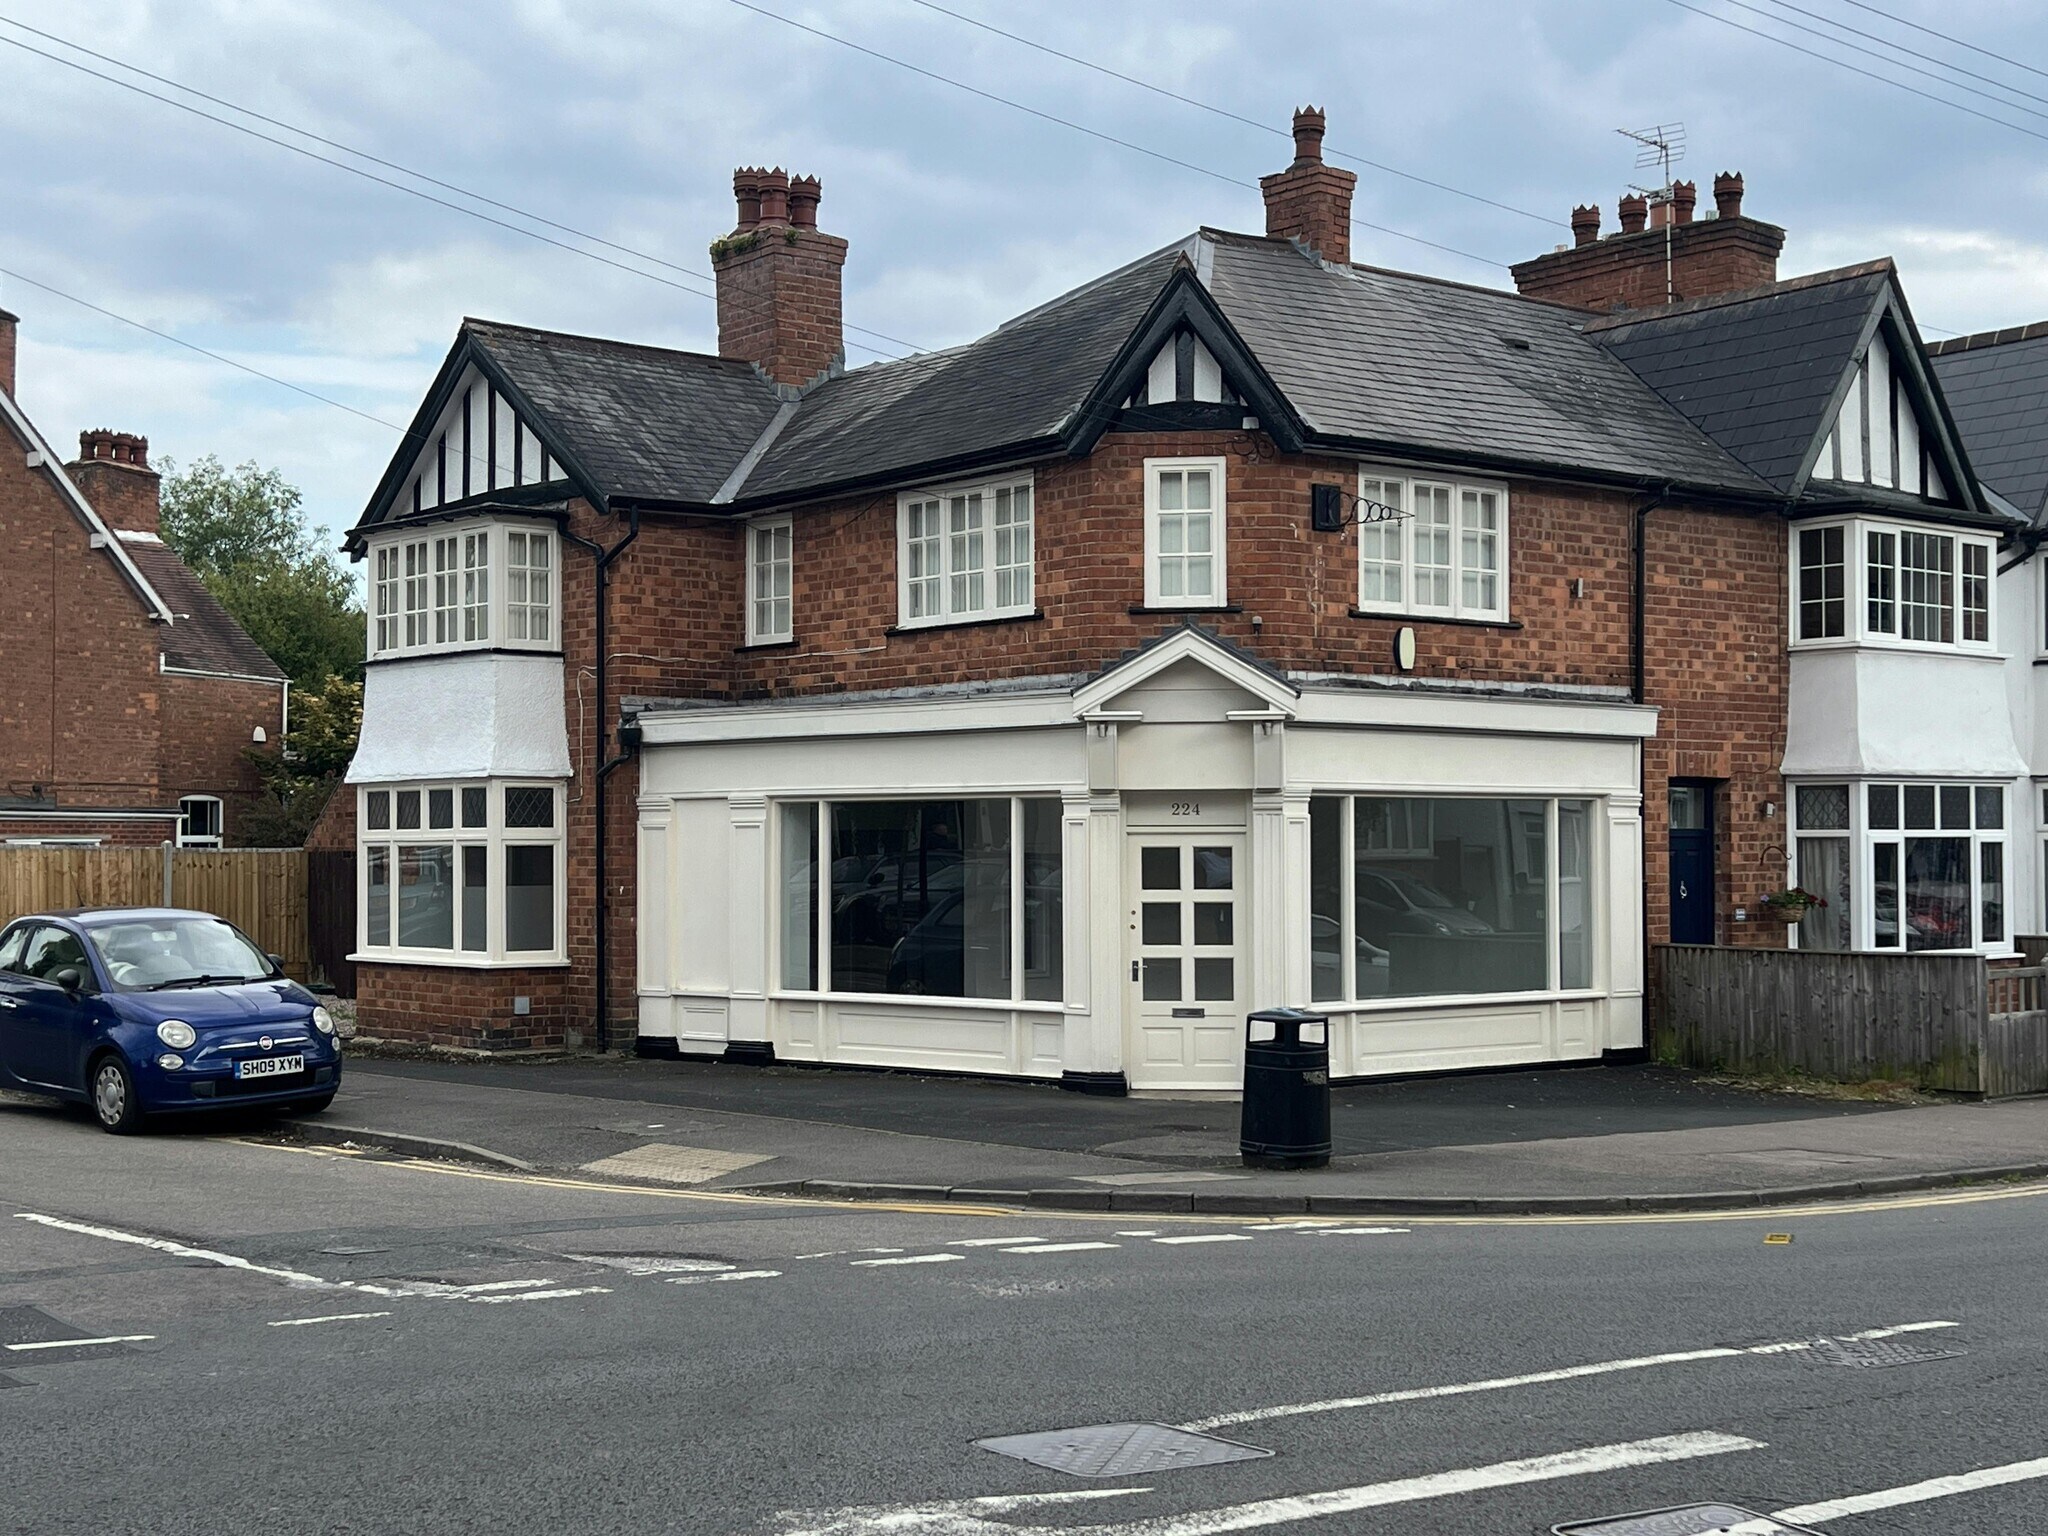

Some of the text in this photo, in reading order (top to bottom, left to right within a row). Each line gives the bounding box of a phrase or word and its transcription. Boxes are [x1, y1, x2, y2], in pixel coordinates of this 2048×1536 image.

[1171, 802, 1200, 816] 224
[243, 1057, 302, 1075] SH09 XYM
